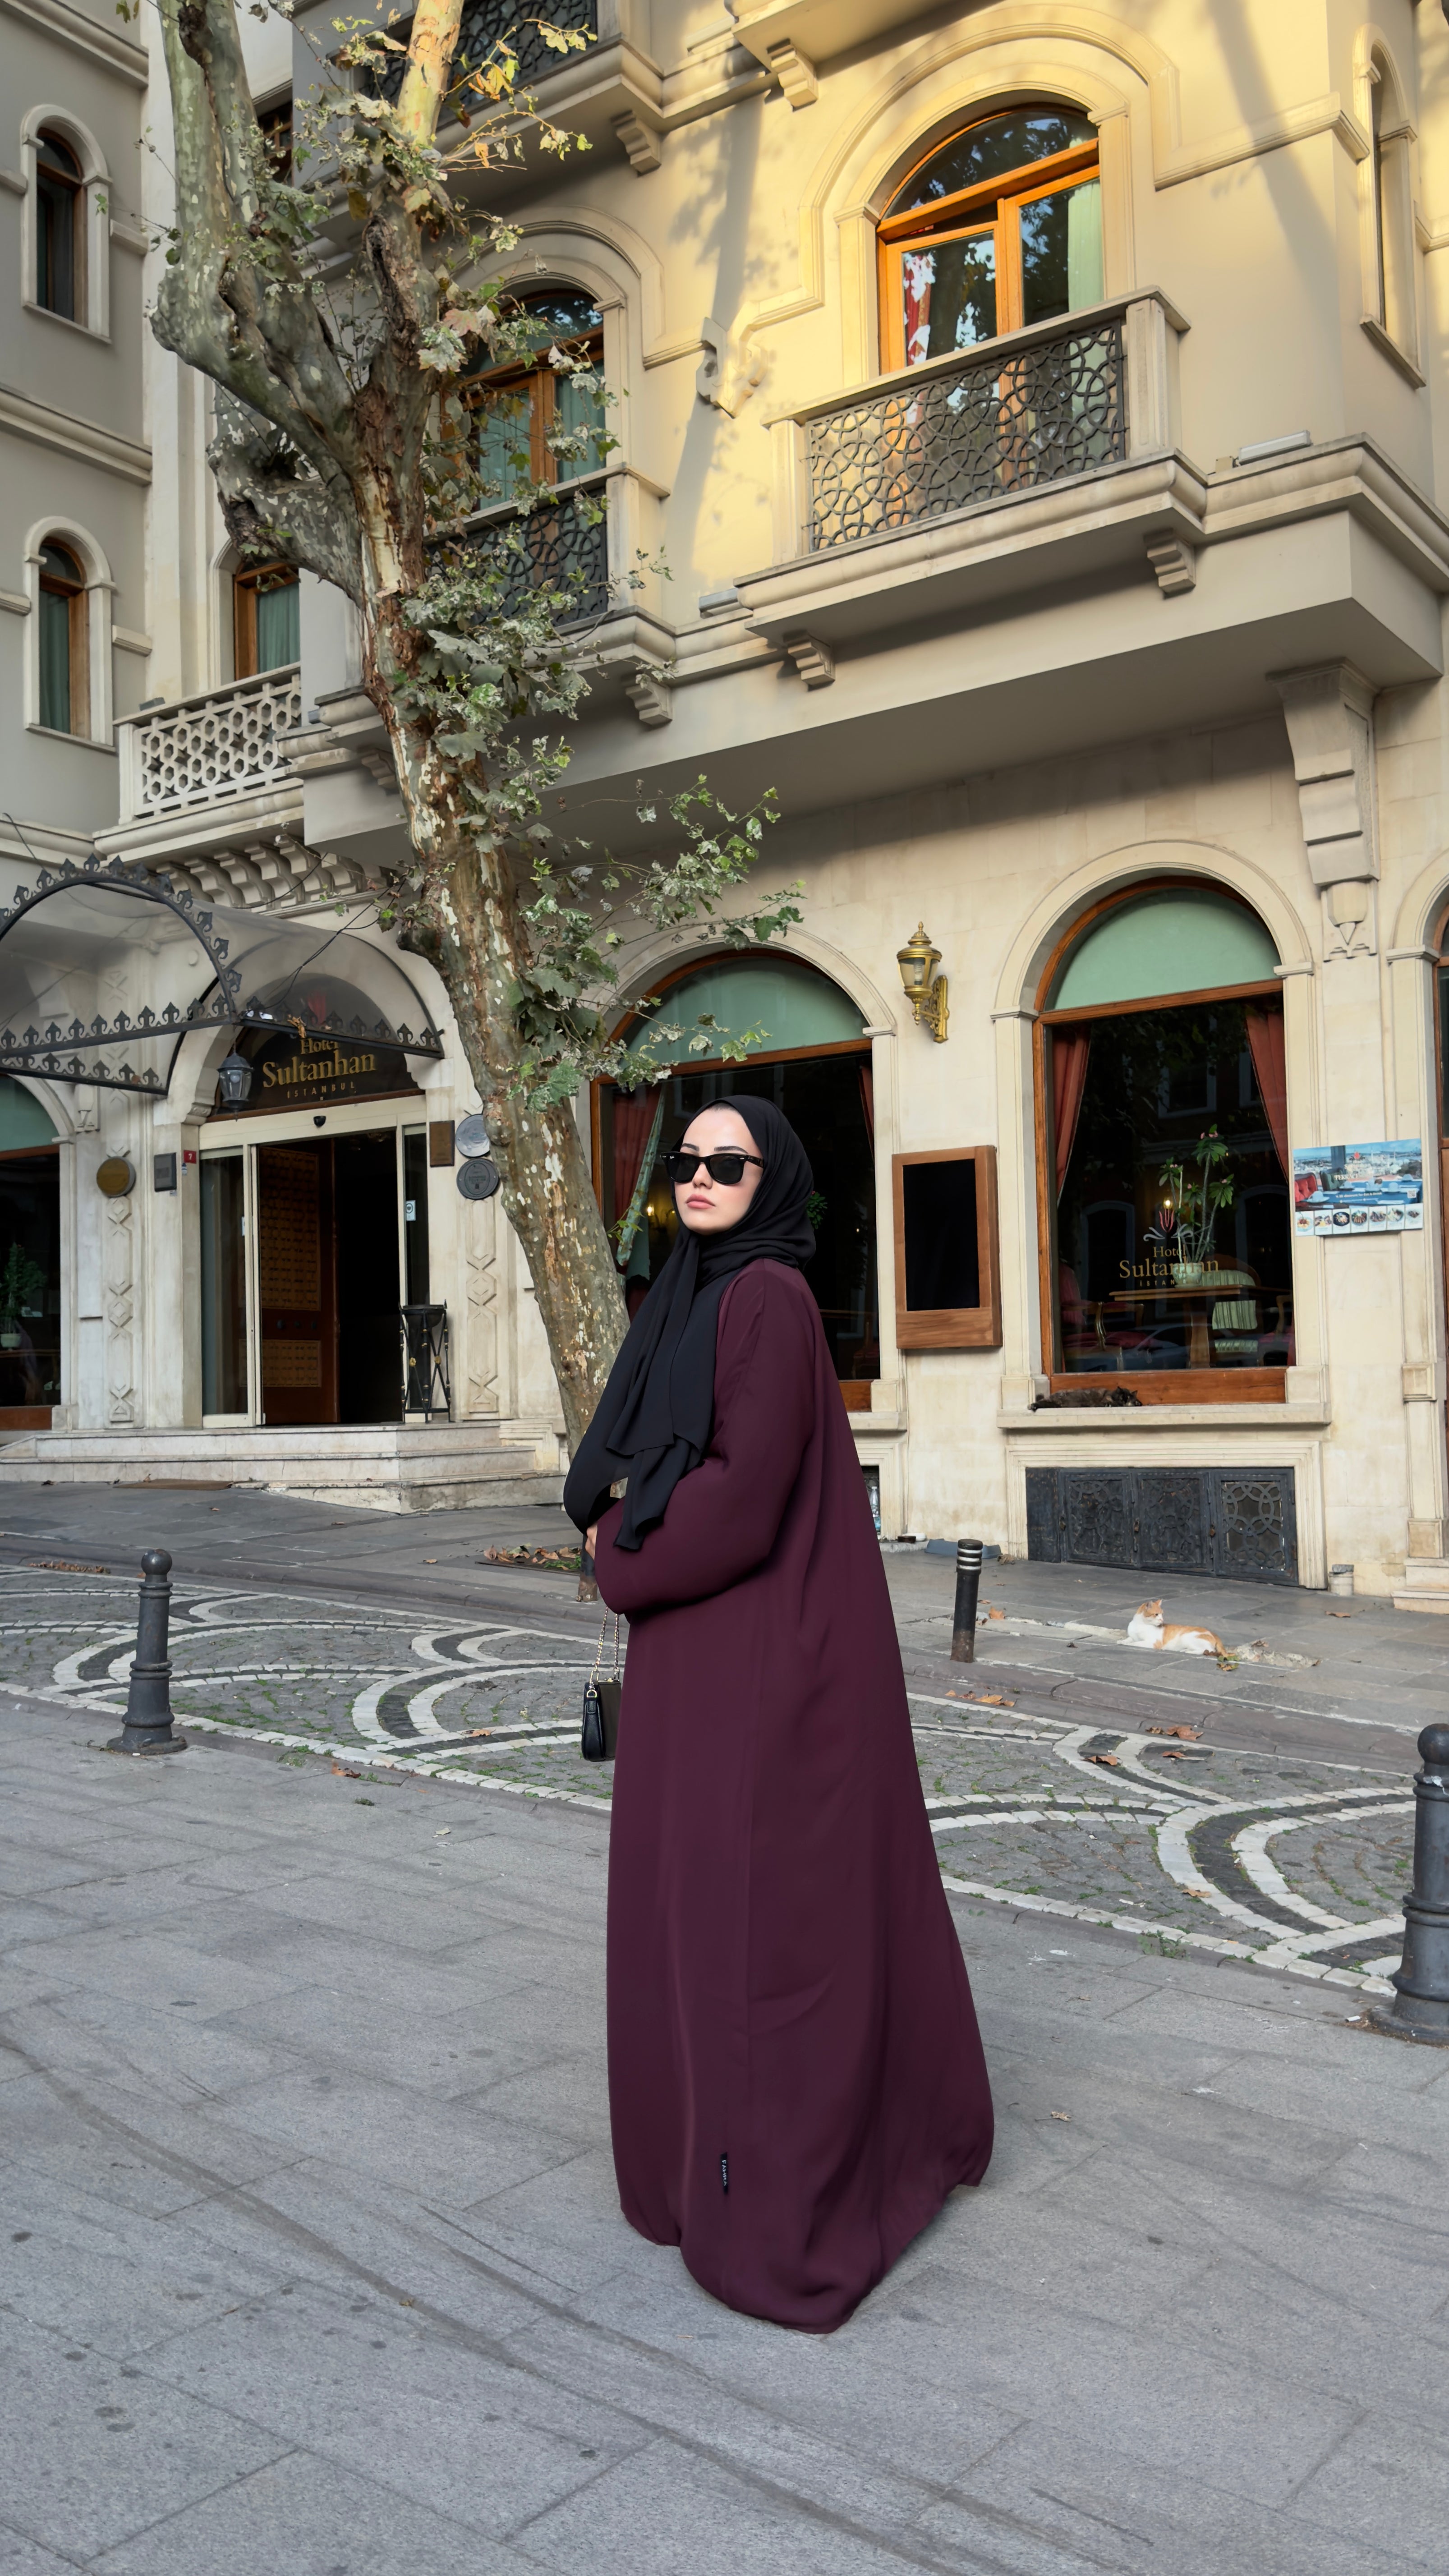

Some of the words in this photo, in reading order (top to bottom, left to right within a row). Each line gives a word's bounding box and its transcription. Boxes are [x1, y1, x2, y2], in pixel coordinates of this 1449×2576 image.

[300, 1038, 339, 1054] Hotel
[262, 1049, 377, 1088] Sultanhan
[1119, 1256, 1219, 1278] Sultanhan
